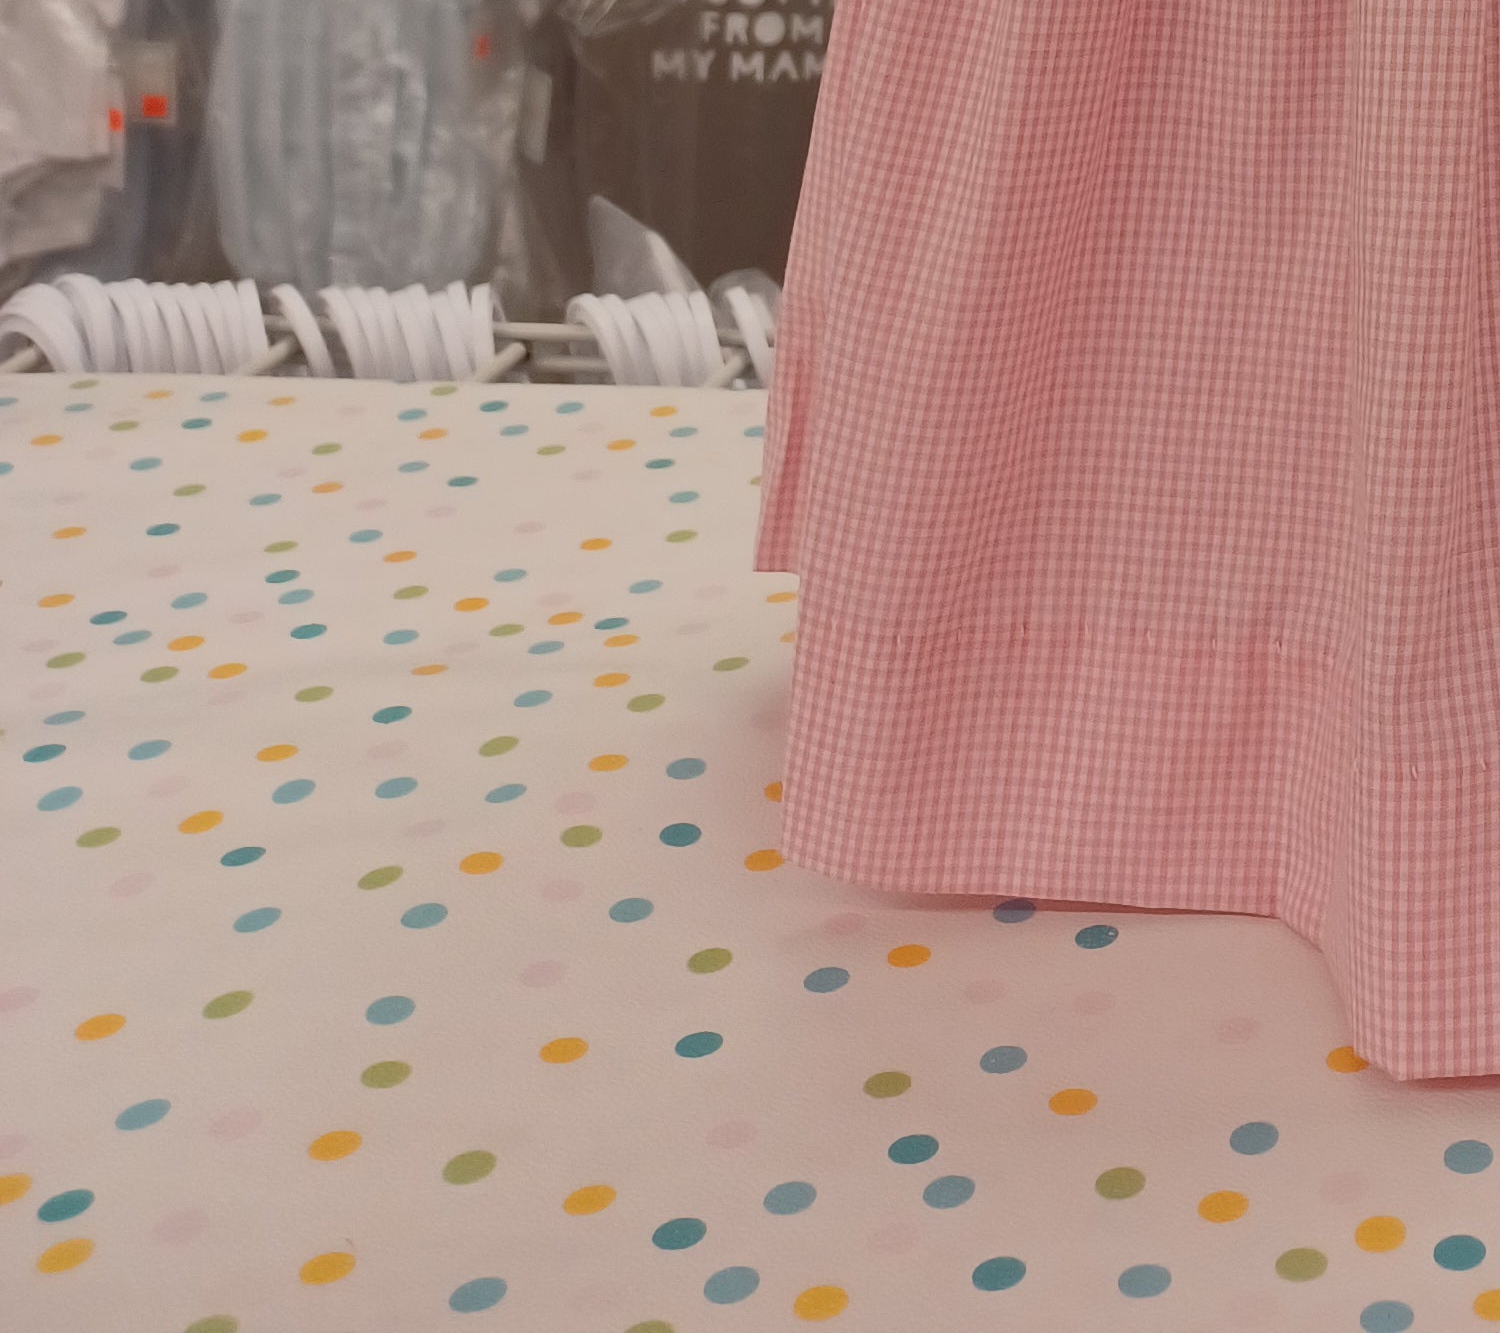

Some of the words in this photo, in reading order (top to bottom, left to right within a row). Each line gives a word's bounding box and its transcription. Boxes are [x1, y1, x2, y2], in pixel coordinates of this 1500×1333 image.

[702, 11, 824, 46] FROM
[653, 50, 716, 81] MY
[731, 50, 825, 82] MAM
